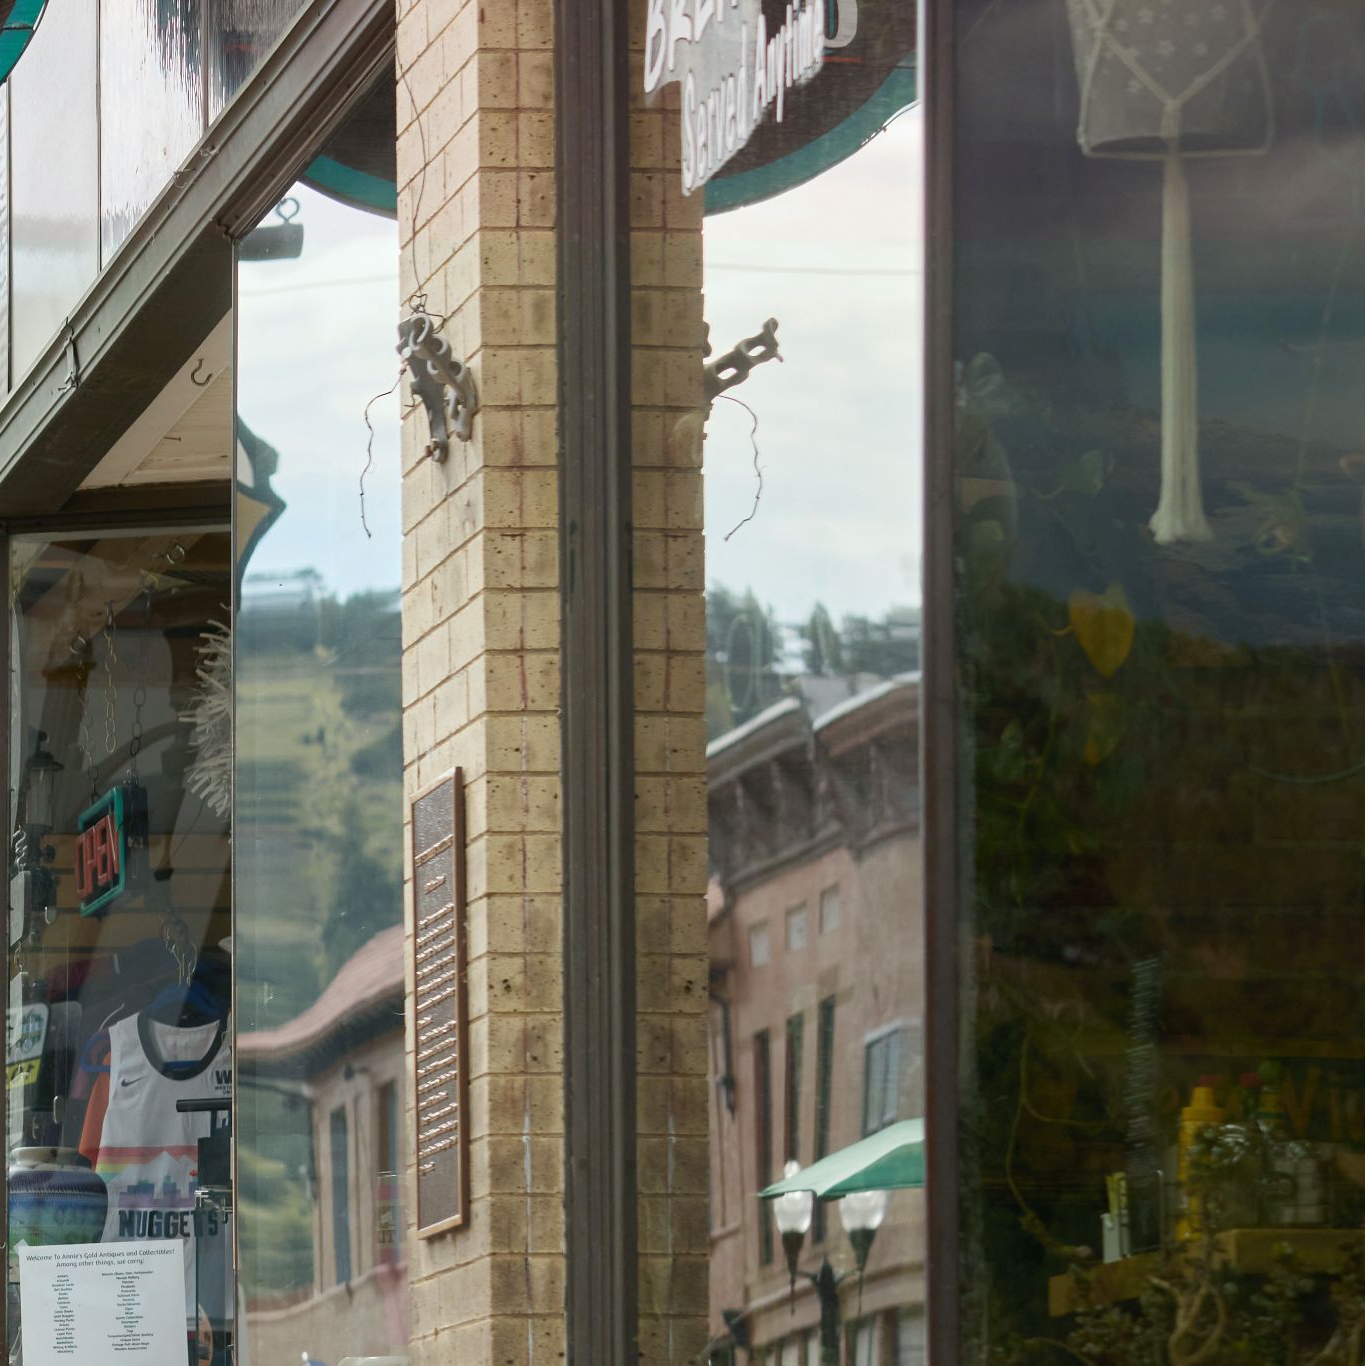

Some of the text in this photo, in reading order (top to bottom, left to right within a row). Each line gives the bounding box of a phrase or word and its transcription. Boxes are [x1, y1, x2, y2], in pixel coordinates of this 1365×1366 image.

[74, 813, 121, 899] OPEN
[118, 1209, 219, 1239] NUGGETS
[26, 1254, 53, 1262] Welcome
[84, 1251, 98, 1259] Gold
[99, 1250, 125, 1259] Antiques
